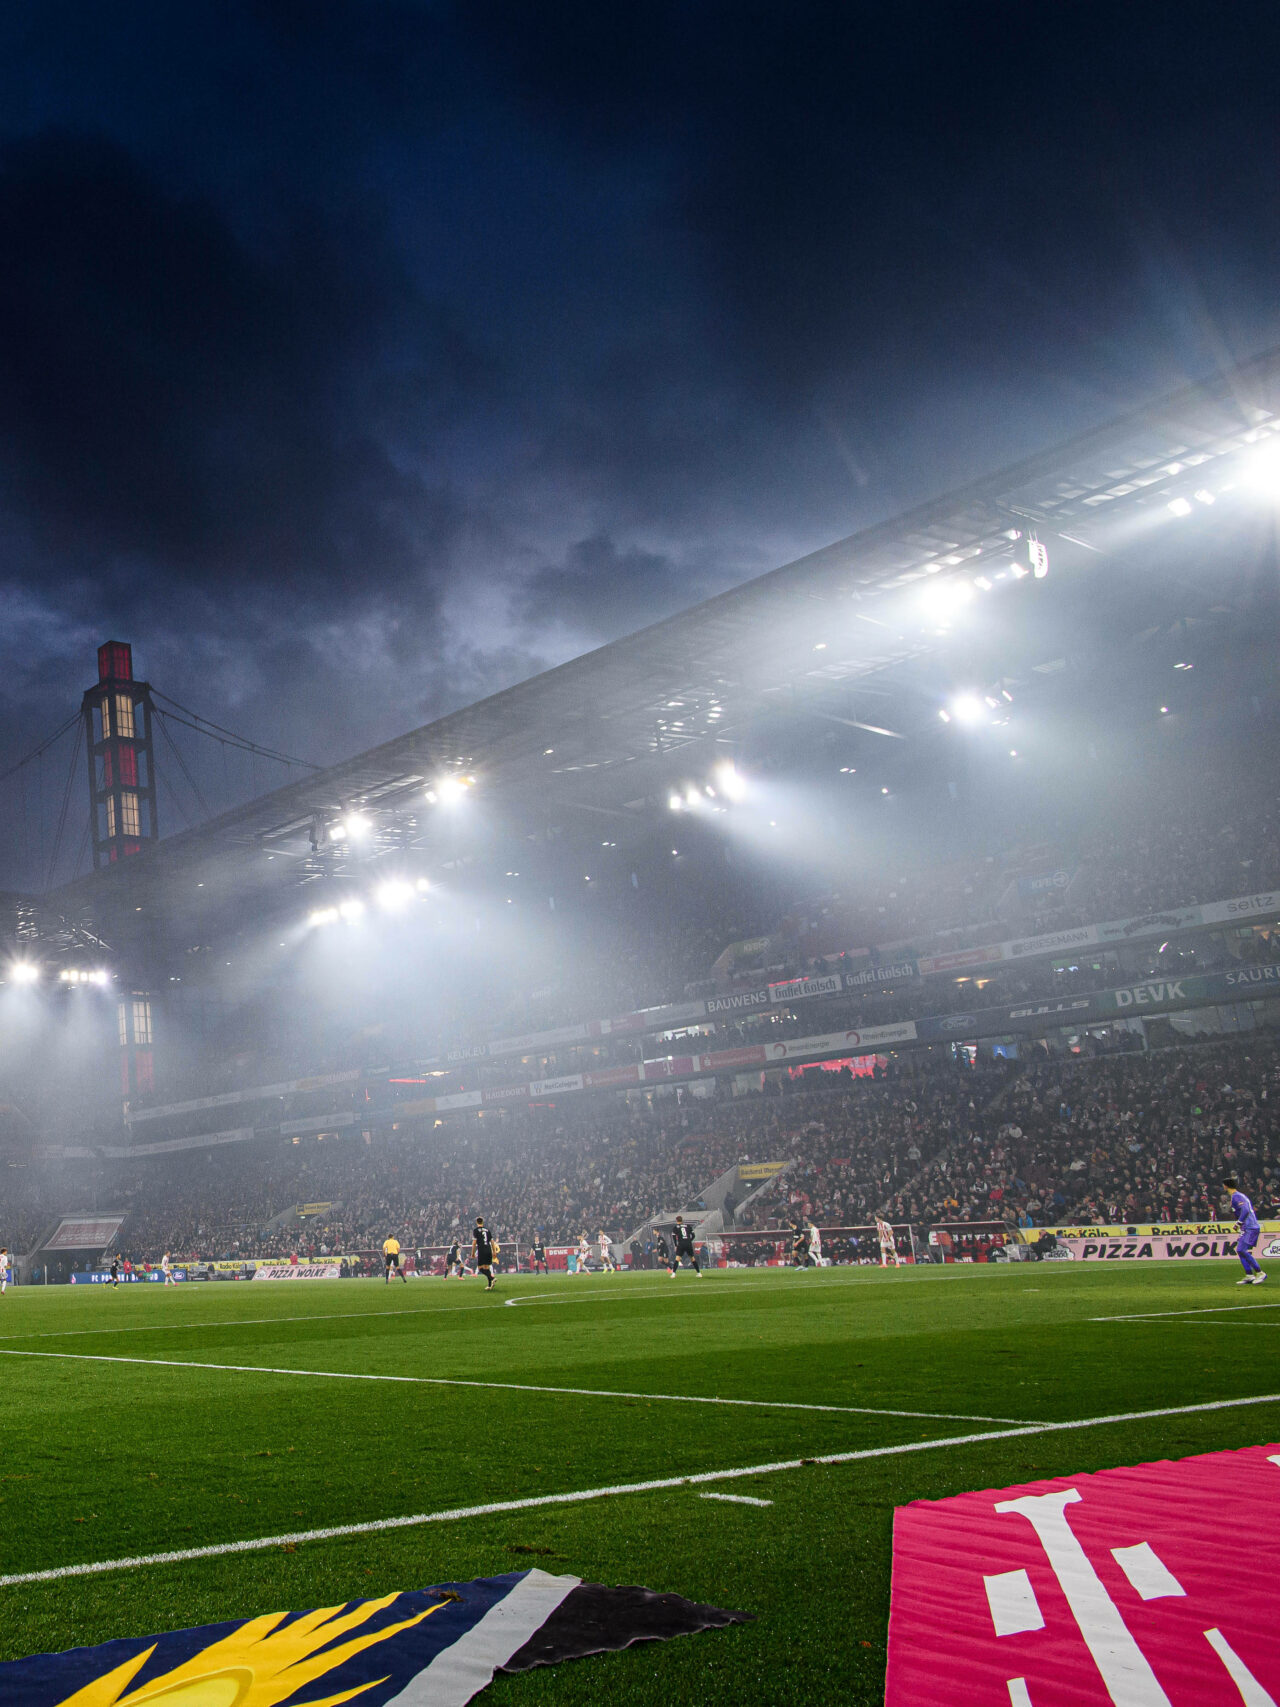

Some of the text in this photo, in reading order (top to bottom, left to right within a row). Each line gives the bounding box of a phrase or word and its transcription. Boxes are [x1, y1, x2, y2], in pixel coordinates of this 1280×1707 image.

[1226, 896, 1276, 913] seitz
[846, 969, 876, 986] Gaffel
[775, 983, 803, 999] Gaffel
[1115, 982, 1187, 1008] DEVK
[707, 991, 767, 1013] BAUWENS
[1151, 1224, 1231, 1236] Radio Köln
[1082, 1243, 1154, 1260] PIZZA
[1166, 1242, 1253, 1258] WOLK
[269, 1269, 295, 1278] PIZZA
[296, 1268, 327, 1278] WOLKE
